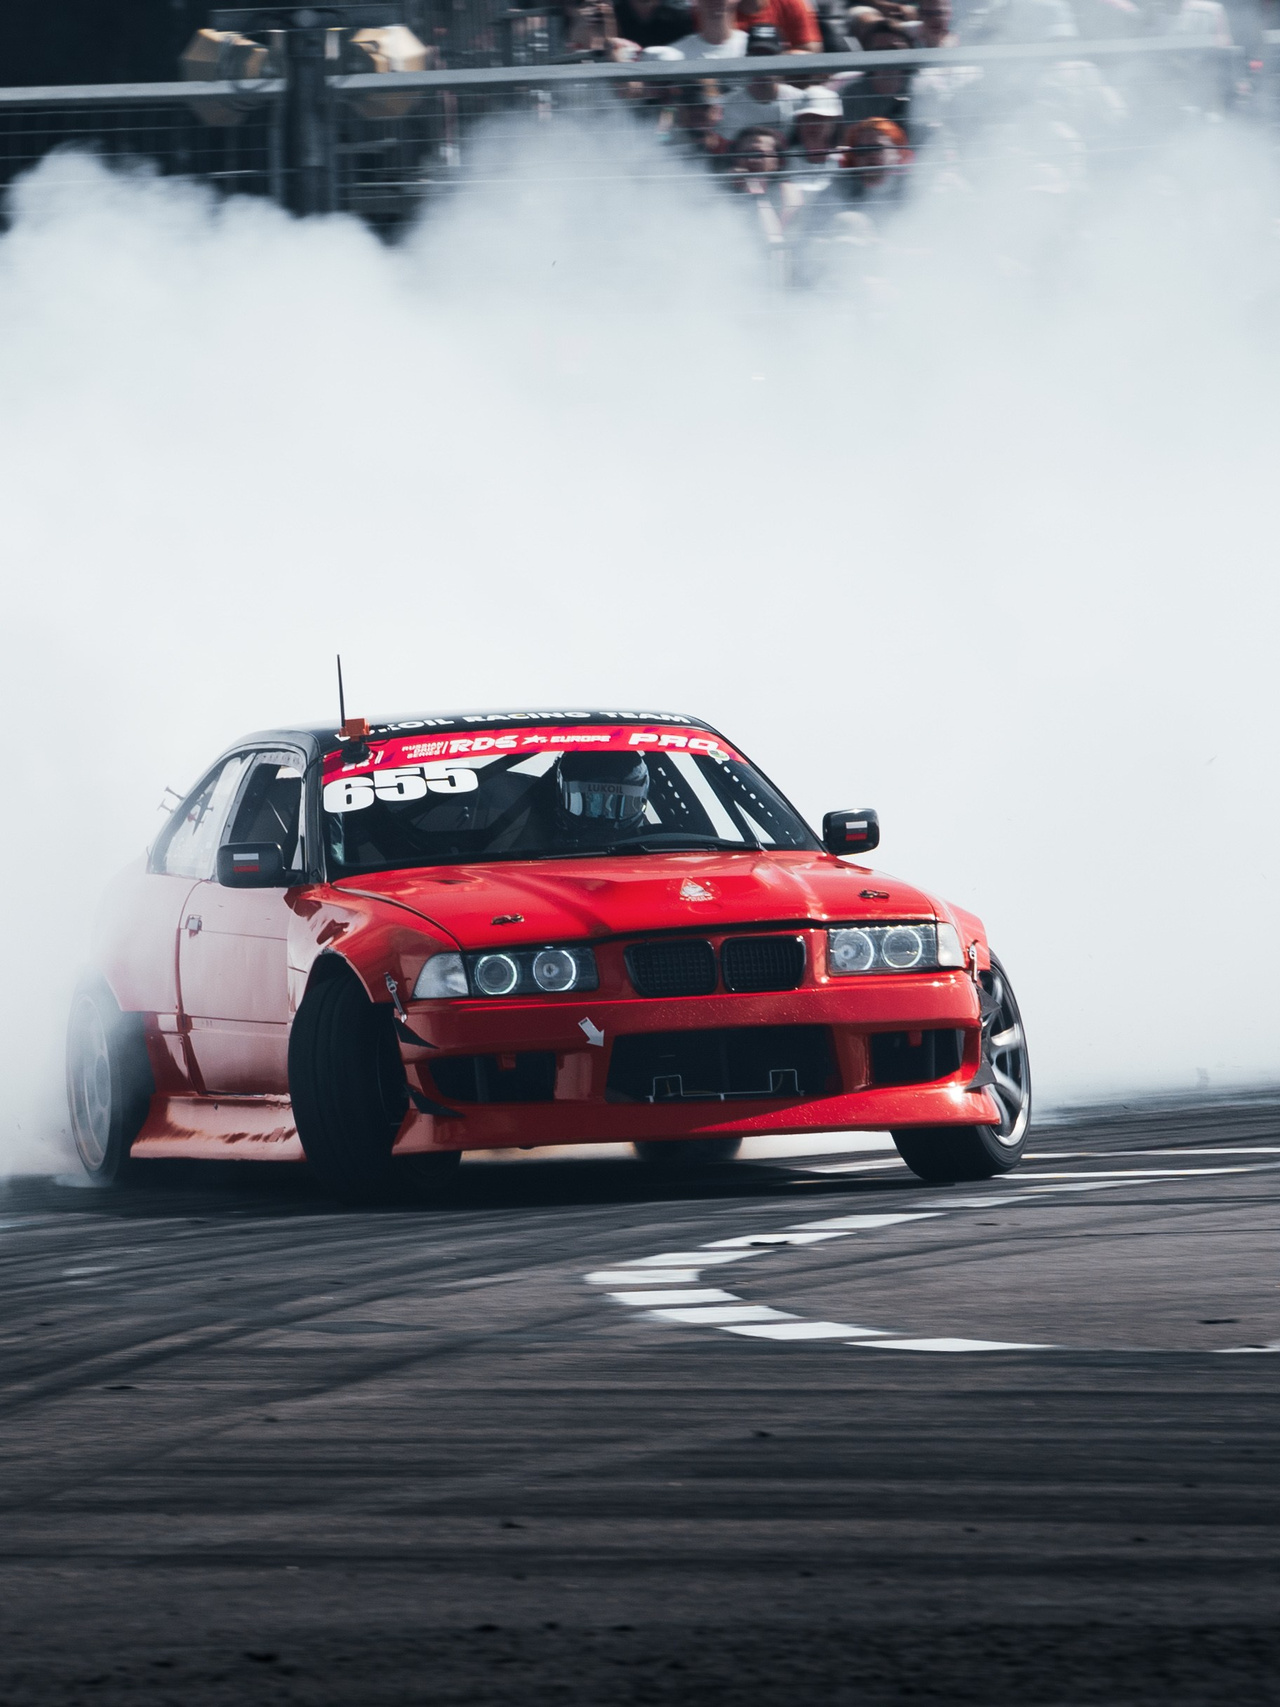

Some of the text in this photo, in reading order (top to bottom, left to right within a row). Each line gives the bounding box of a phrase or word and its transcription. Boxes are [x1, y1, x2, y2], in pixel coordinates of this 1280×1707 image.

[462, 711, 591, 723] RACING
[599, 711, 691, 724] TEAM
[550, 735, 612, 743] EUROPE
[628, 733, 720, 751] PRO
[322, 762, 479, 814] 655
